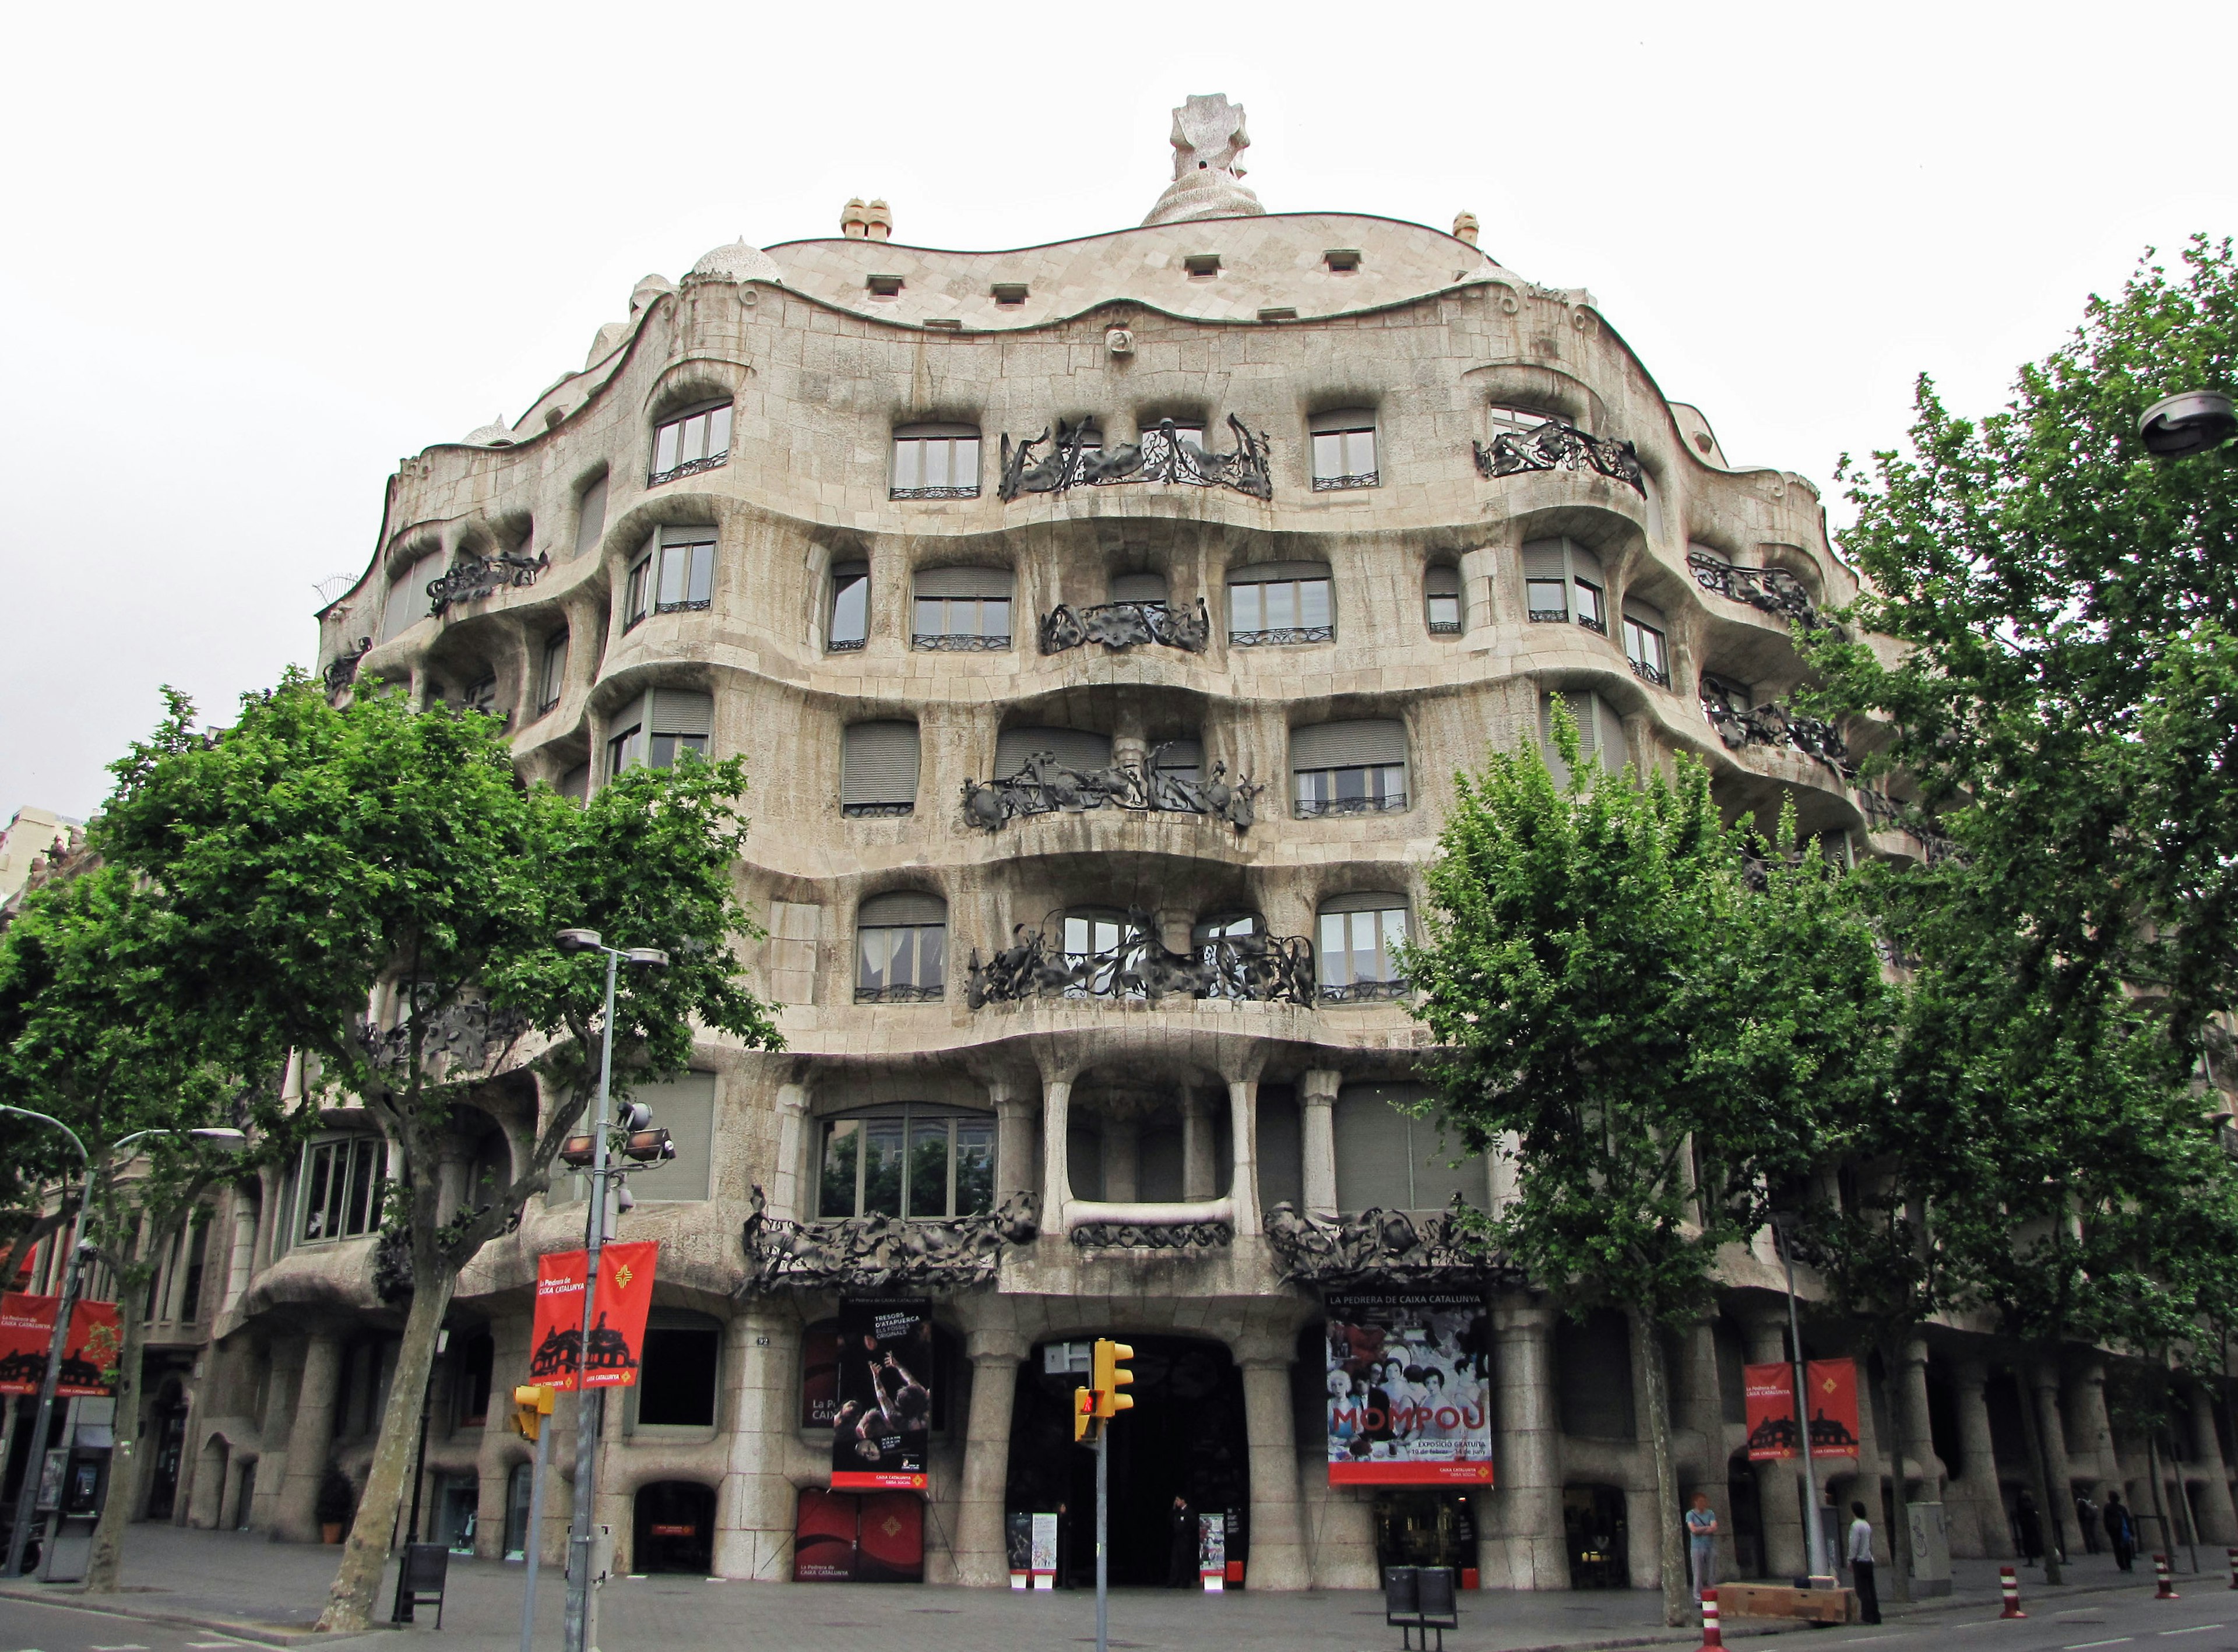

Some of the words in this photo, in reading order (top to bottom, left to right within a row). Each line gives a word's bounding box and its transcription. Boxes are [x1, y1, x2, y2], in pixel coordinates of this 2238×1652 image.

[539, 1287, 554, 1295] CAIXA
[555, 1283, 585, 1293] CATALUNYA
[1429, 1295, 1481, 1304] CATALUNYA
[875, 1312, 904, 1322] TRESORS
[875, 1316, 920, 1328] D'ATAPUERCA
[813, 1400, 824, 1408] La
[1333, 1406, 1485, 1431] MOMPOU
